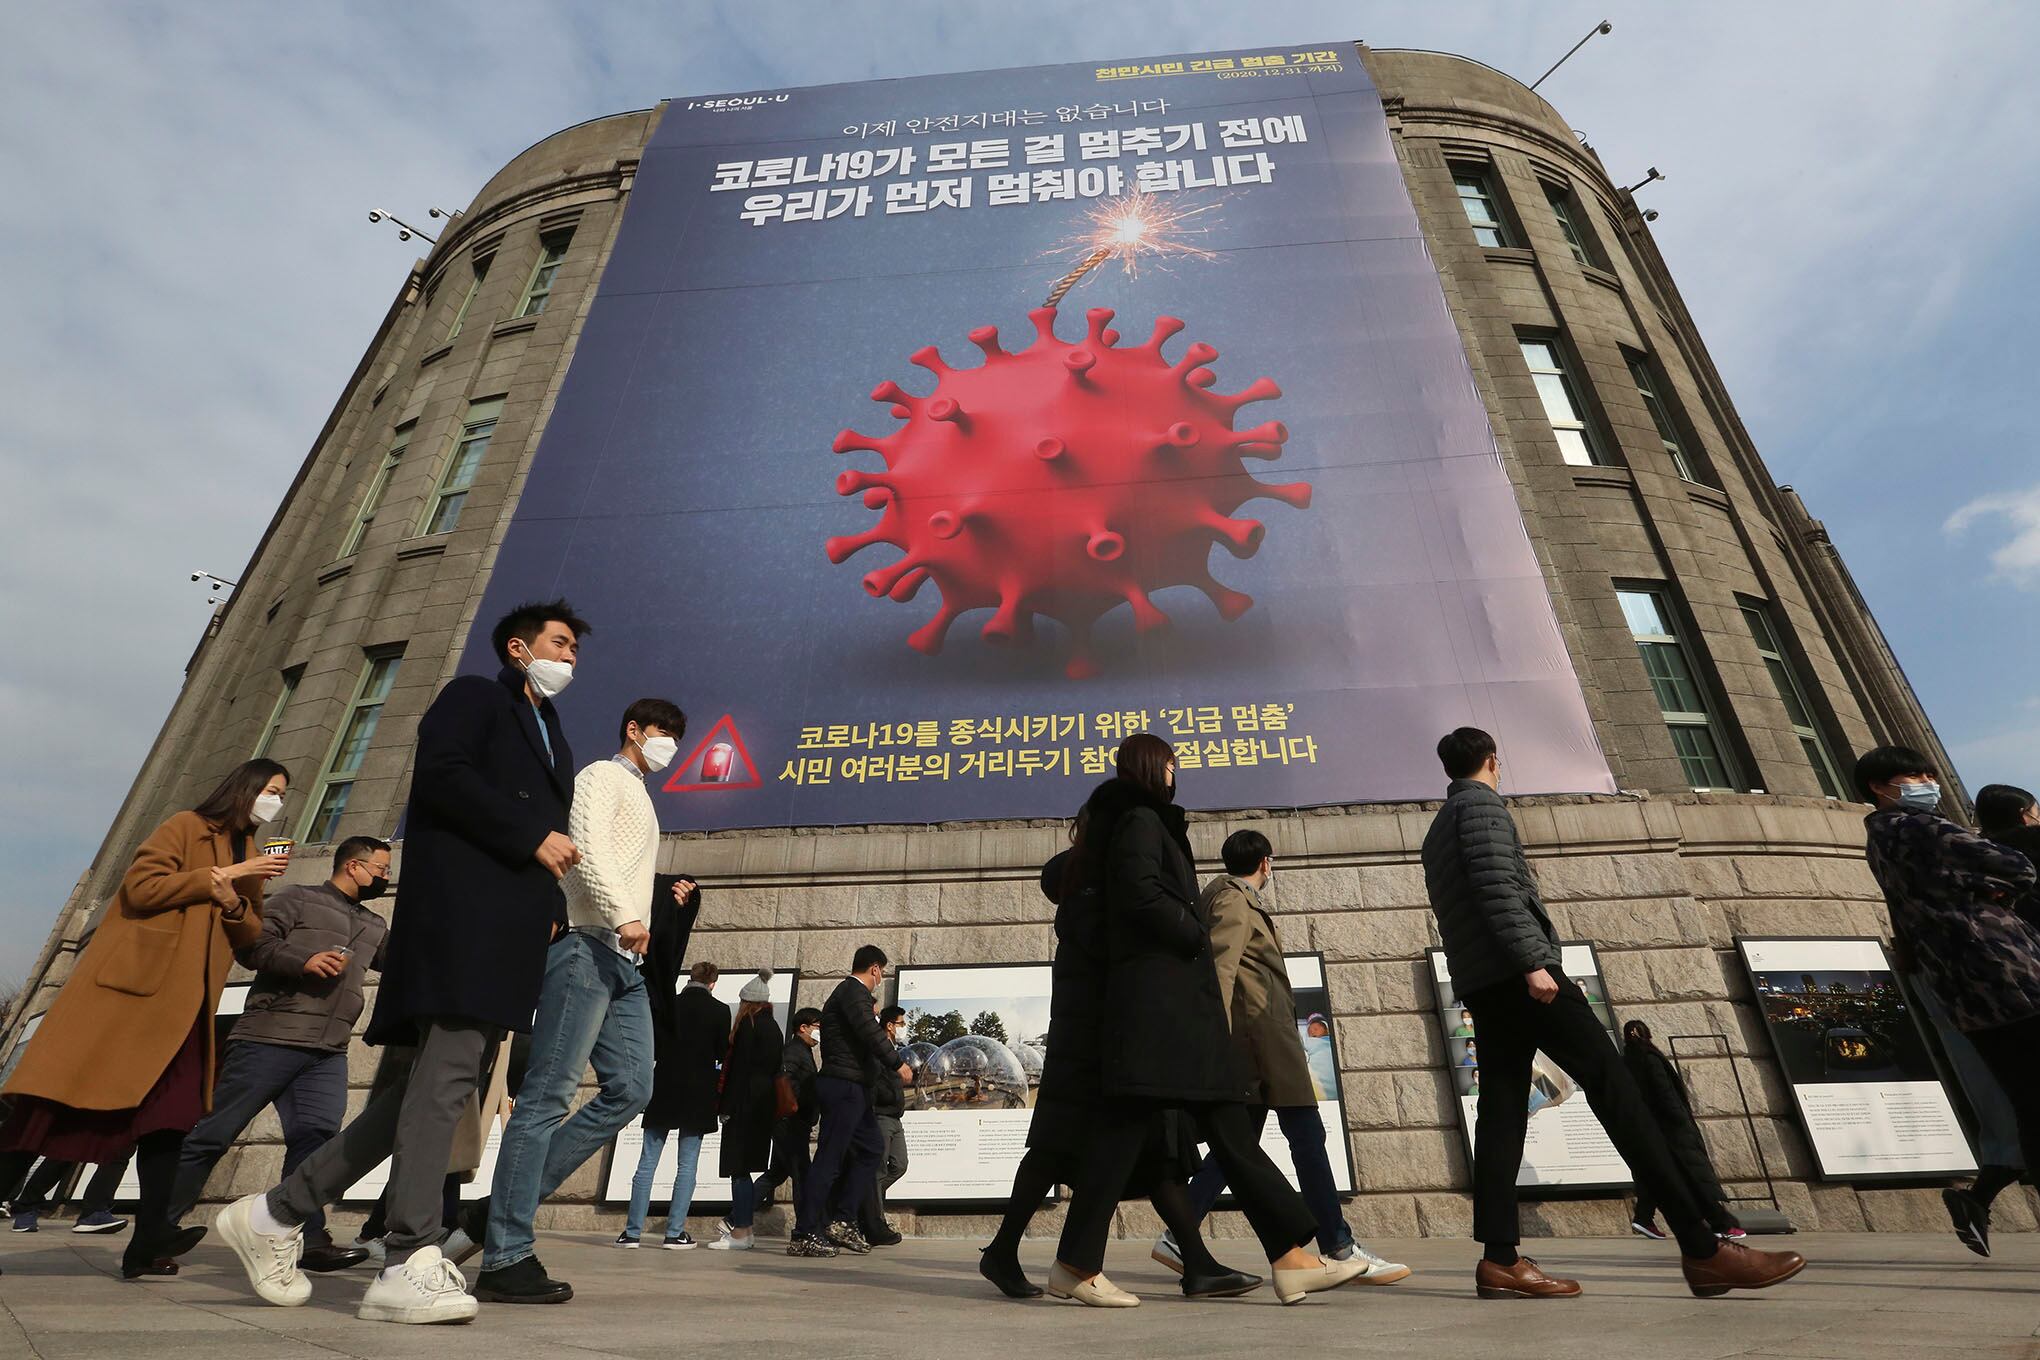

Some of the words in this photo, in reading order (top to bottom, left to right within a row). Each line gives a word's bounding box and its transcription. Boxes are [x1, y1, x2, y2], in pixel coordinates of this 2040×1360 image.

[1096, 62, 1184, 79] 천만시민
[1190, 59, 1234, 71] 긴급
[1240, 55, 1286, 68] 멈춤
[1291, 51, 1337, 64] 기간
[843, 119, 897, 139] 이제
[906, 110, 1048, 135] 안전지대는
[1055, 98, 1171, 123] 없습니다
[710, 147, 916, 192] 코로나19가
[926, 138, 1010, 173] 모든
[1025, 134, 1066, 165] 걸
[1079, 122, 1207, 160] 멈추기
[1219, 115, 1308, 148] 전에
[739, 185, 874, 226] 우리가
[886, 176, 973, 215] 먼저
[988, 165, 1124, 206] 멈춰야
[1136, 152, 1276, 194] 합니다
[797, 720, 941, 750] 코로나19를
[948, 713, 1085, 746] 종식시키기
[1095, 710, 1151, 739] 위한
[778, 756, 833, 785] 시민
[841, 752, 951, 783] 여러분의
[958, 747, 1070, 778] 거리두기
[1173, 735, 1318, 769] 절실합니다
